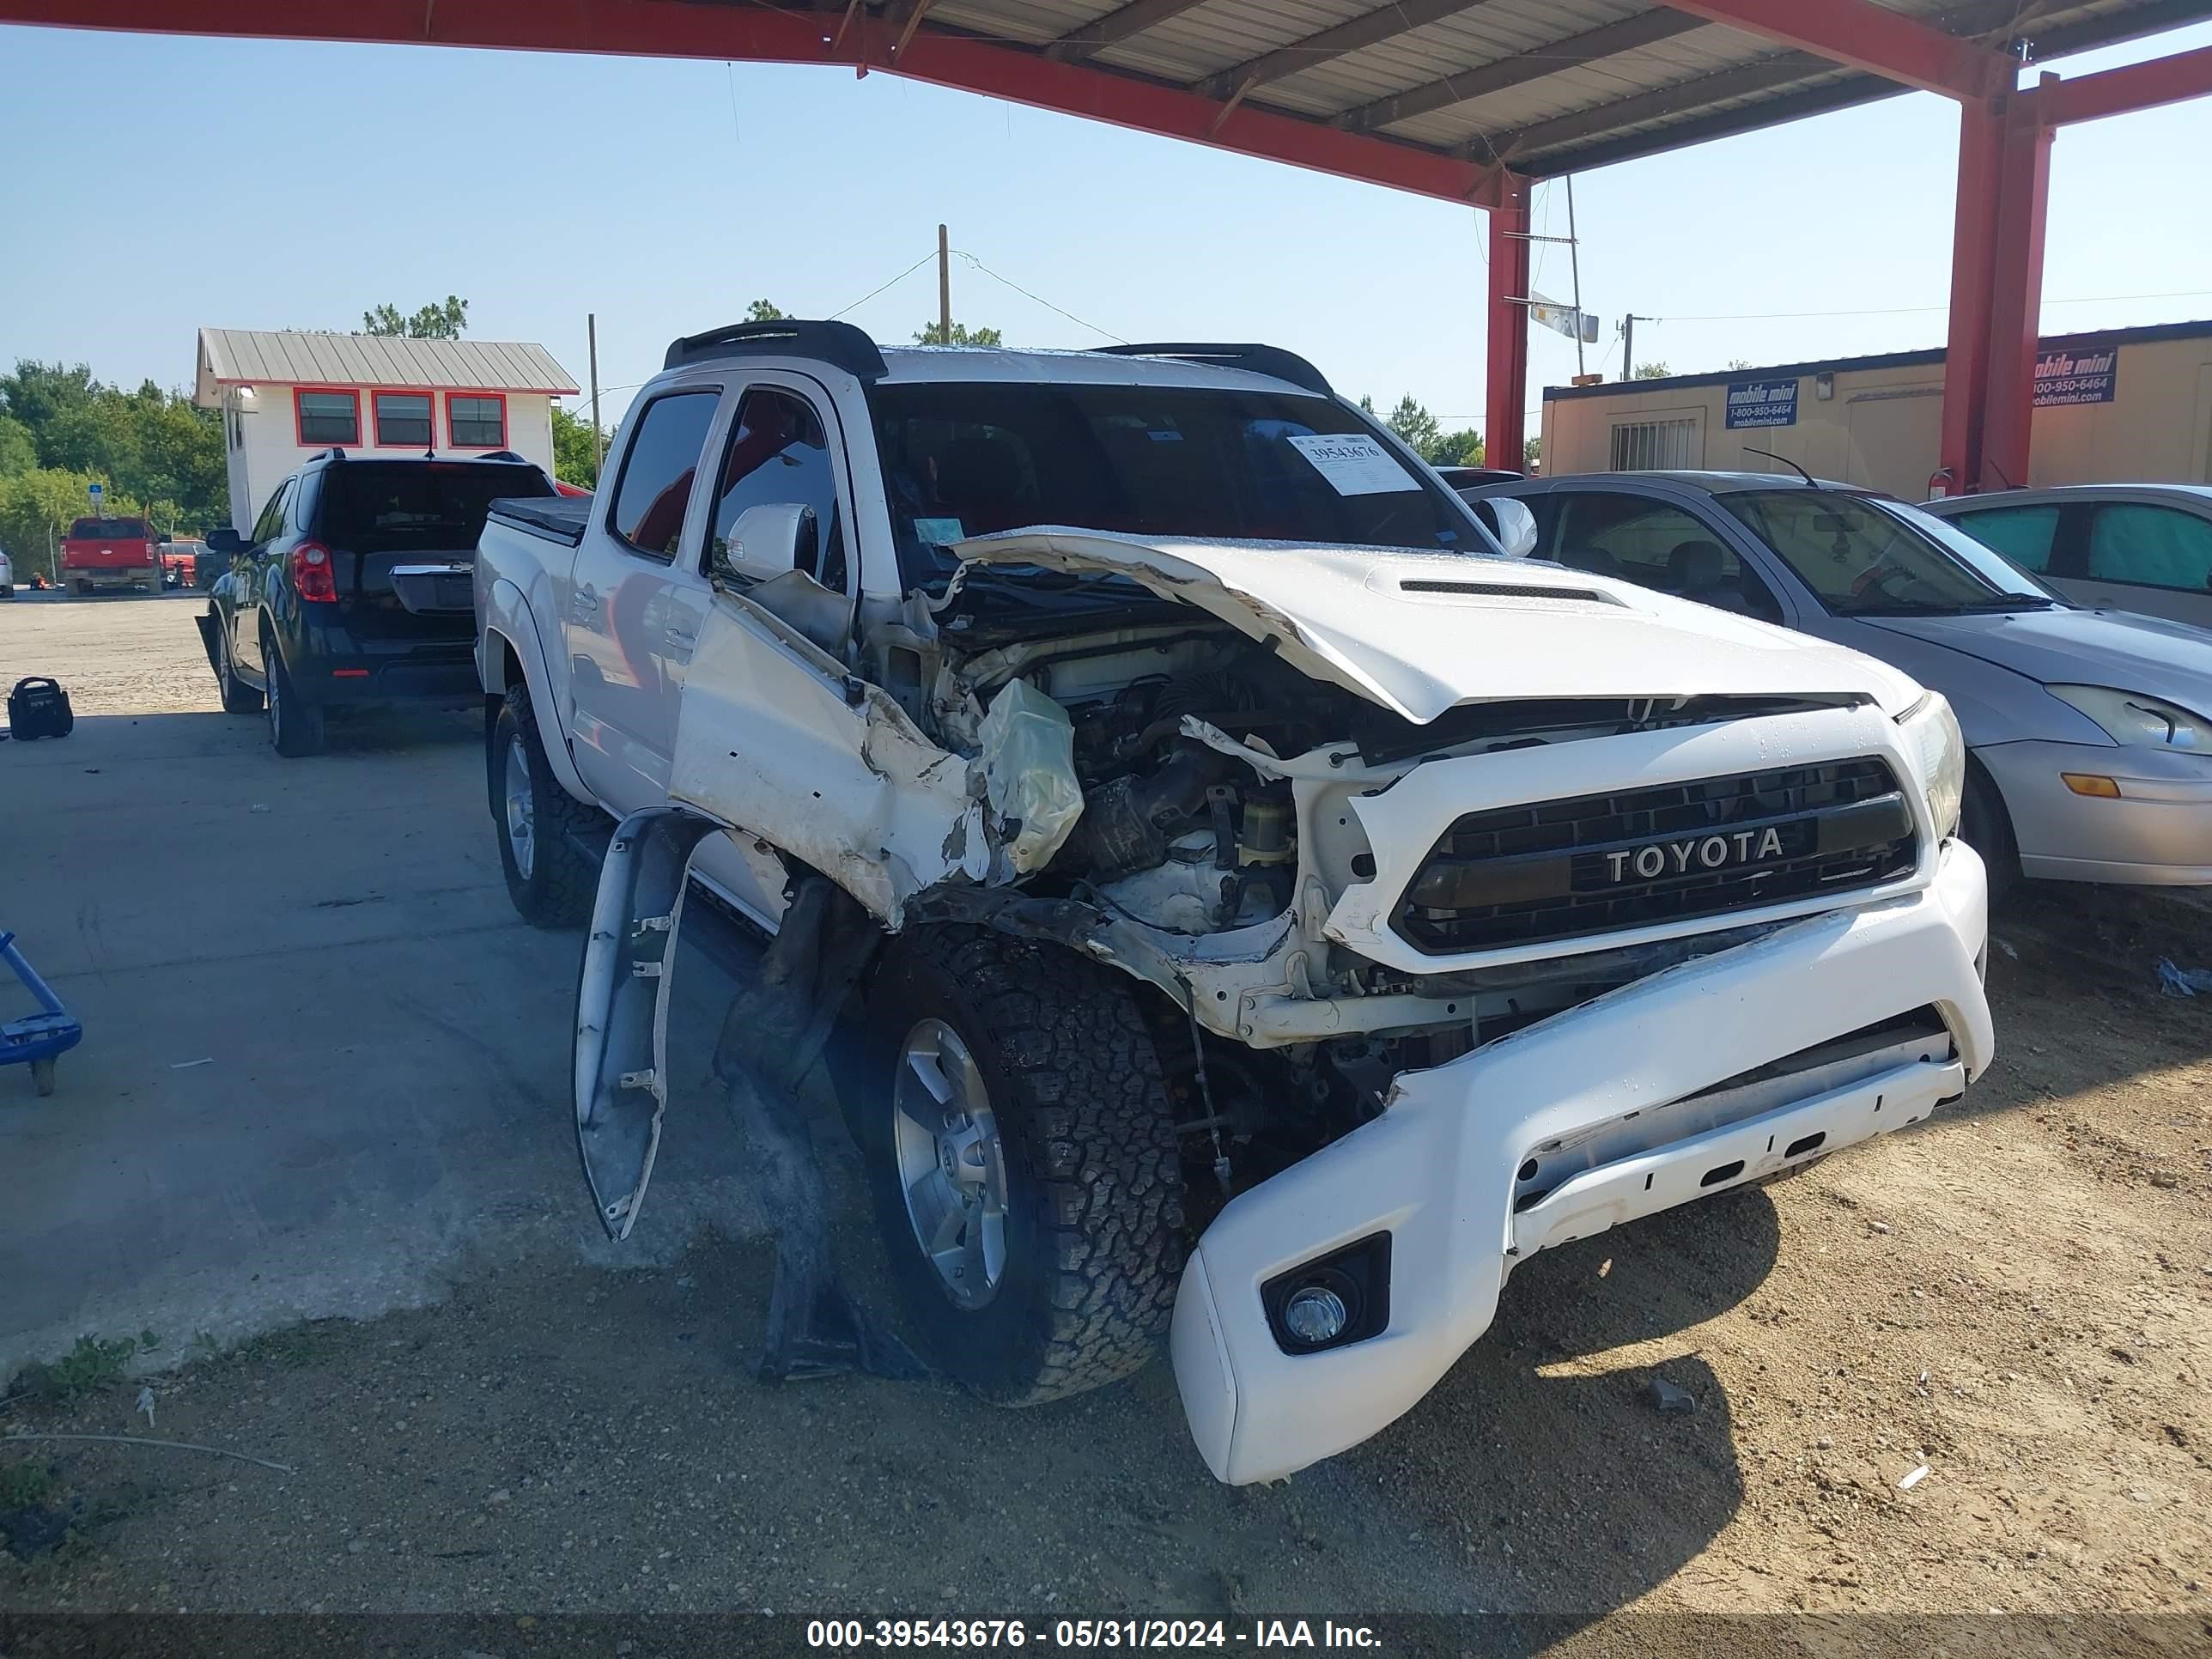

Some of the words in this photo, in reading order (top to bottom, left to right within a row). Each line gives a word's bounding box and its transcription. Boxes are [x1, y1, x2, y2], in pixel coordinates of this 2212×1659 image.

[2034, 354, 2074, 379] obile
[2074, 352, 2114, 374] mini
[1729, 384, 1768, 404] mobile
[1768, 384, 1796, 402] mini
[2033, 392, 2102, 406] obilemini.com
[1731, 404, 1792, 418] 1-800-950-6464
[1734, 416, 1788, 428] mobilemini.com
[1310, 446, 1380, 460] 39543676
[1607, 827, 1783, 883] TOYOTA
